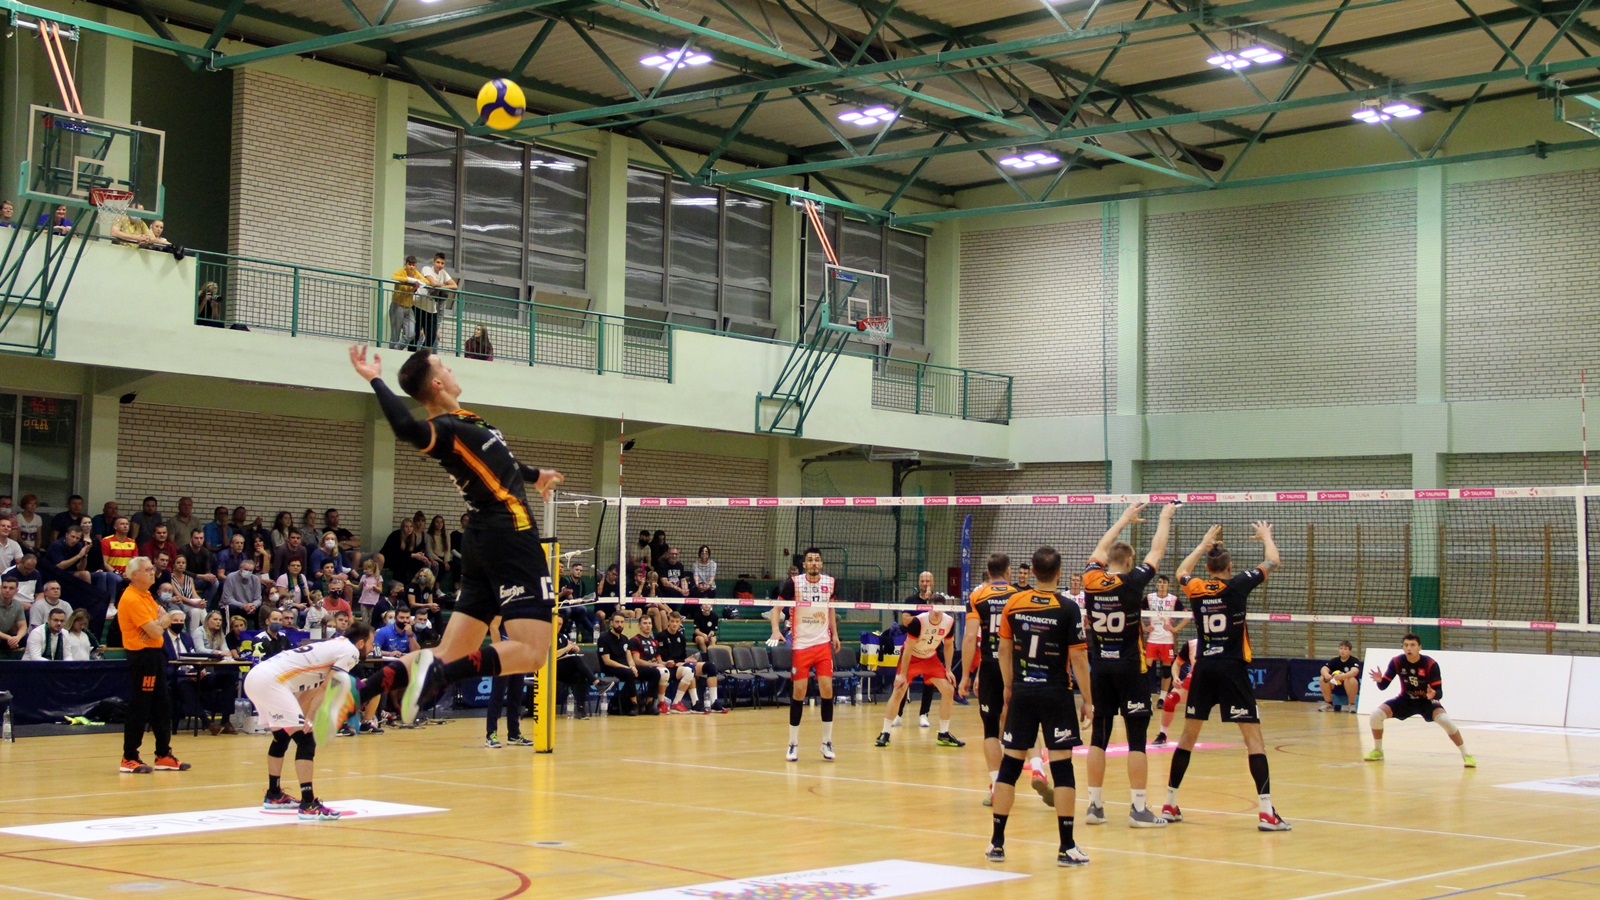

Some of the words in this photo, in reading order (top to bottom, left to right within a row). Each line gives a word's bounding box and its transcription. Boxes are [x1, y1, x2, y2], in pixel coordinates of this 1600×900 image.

[1014, 613, 1057, 625] MACIONCZYK
[1091, 611, 1125, 633] 20
[1203, 613, 1227, 634] 10
[927, 636, 934, 645] 3
[1028, 634, 1039, 658] 1
